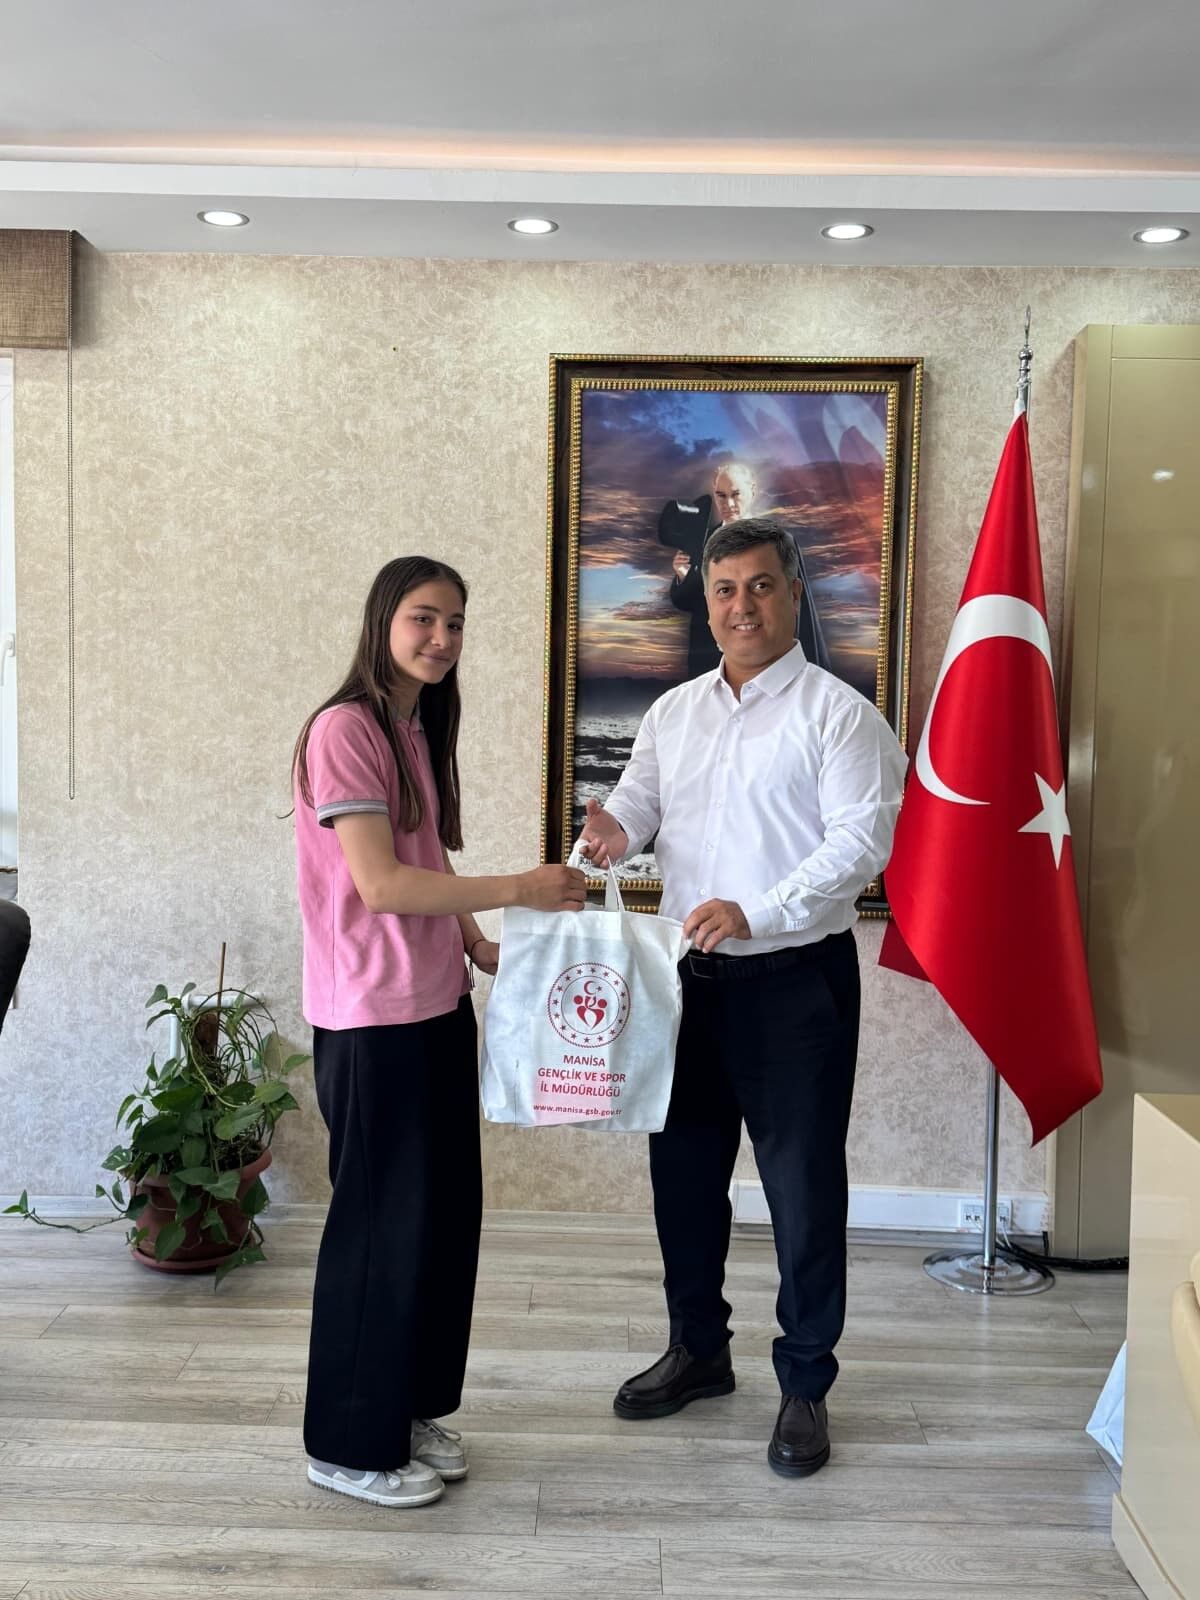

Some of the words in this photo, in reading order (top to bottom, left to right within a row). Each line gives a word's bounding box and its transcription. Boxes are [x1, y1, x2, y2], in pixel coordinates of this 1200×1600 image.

[563, 1055, 605, 1066] MANİSA
[538, 1067, 581, 1080] GENÇLİK
[584, 1072, 597, 1081] VE
[600, 1073, 626, 1082] SPOR
[540, 1080, 549, 1092] İL
[551, 1083, 620, 1097] MÜDÜRLÜĞÜ
[533, 1104, 622, 1116] www.manisa.gsb.gov.tr
